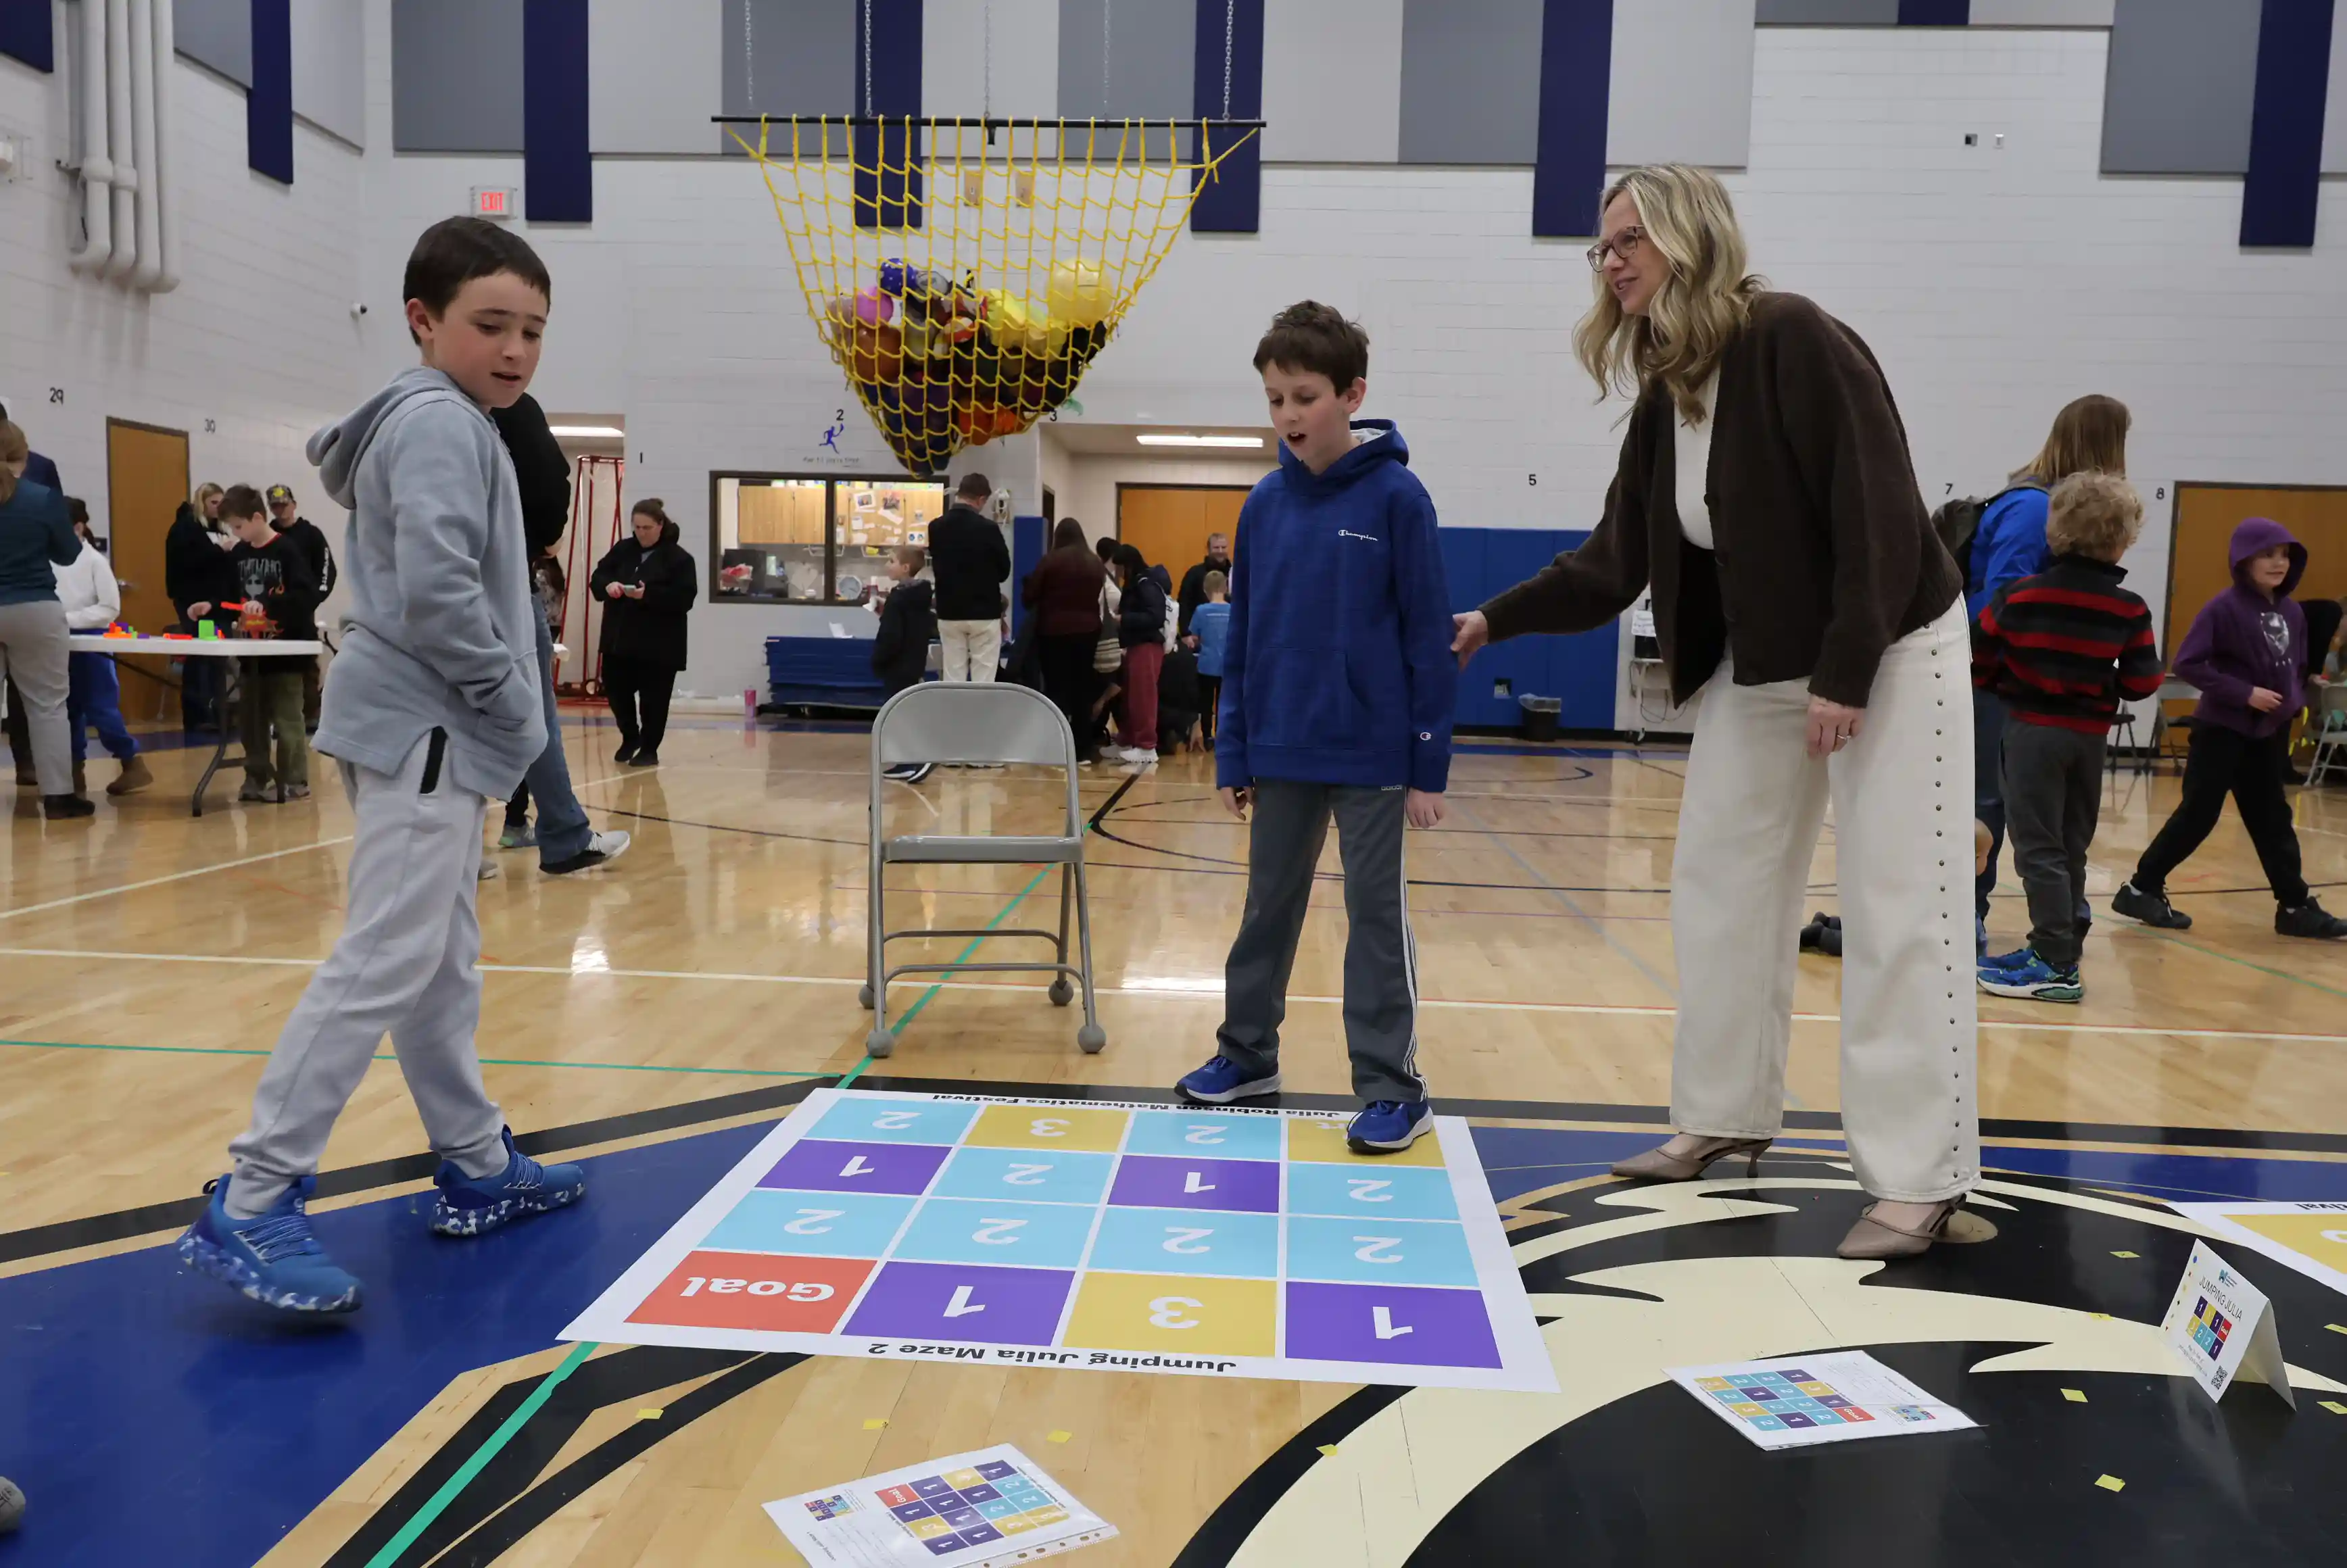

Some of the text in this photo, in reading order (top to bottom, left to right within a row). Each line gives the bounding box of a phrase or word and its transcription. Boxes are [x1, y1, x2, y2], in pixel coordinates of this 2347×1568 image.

[481, 192, 504, 211] EXIT
[49, 387, 64, 405] 29
[836, 409, 844, 421] 2
[1049, 410, 1057, 422] 3
[204, 418, 216, 433] 30
[1528, 473, 1537, 486] 5
[1945, 483, 1953, 495] 7
[2156, 487, 2164, 499] 8
[1338, 529, 1378, 541] Champion
[933, 1095, 1019, 1103] Festival
[1025, 1099, 1169, 1110] Mathematics
[872, 1110, 921, 1129] 2
[1176, 1105, 1279, 1115] Robinson
[1030, 1118, 1071, 1137] 3
[1184, 1125, 1228, 1144] 2
[838, 1155, 875, 1177] 1
[1002, 1163, 1054, 1185] 2
[1184, 1171, 1215, 1194] 1
[1347, 1179, 1393, 1202] 2
[783, 1208, 846, 1235] 2
[971, 1218, 1029, 1244] 2
[1162, 1227, 1214, 1254] 2
[1353, 1235, 1403, 1264] 2
[679, 1277, 835, 1302] Goal
[2199, 1275, 2226, 1306] JUMPING
[2225, 1299, 2242, 1322] JULIA
[942, 1285, 986, 1317] 1
[1148, 1296, 1205, 1329] 3
[1372, 1306, 1413, 1340] 1
[867, 1342, 1236, 1373] Jumping Julia Maze 2
[888, 1488, 906, 1503] Goal
